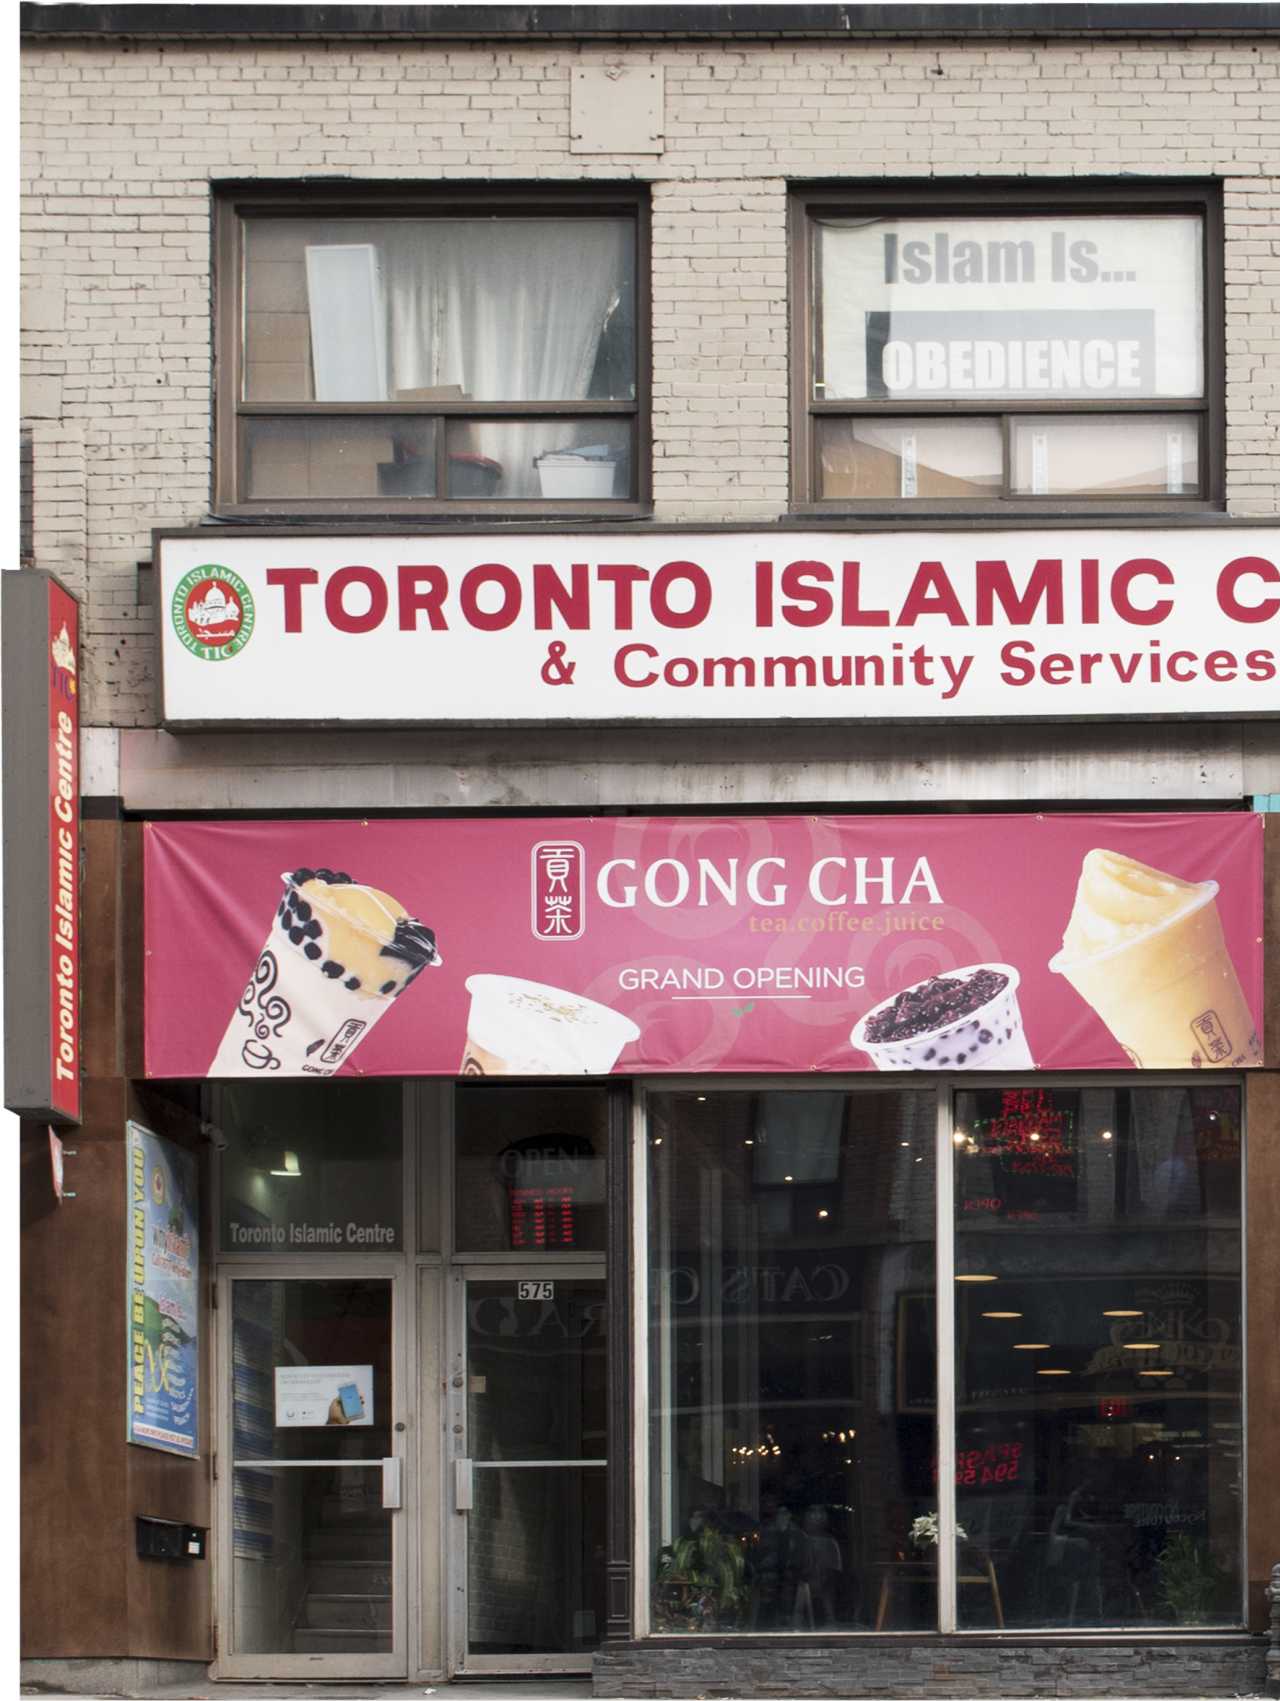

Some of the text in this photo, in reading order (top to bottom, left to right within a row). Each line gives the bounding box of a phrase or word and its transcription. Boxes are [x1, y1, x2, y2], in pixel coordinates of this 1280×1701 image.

[884, 231, 1136, 284] Islam Is...
[881, 340, 1142, 391] OBEDIENCE
[173, 567, 254, 653] TORONTO ISLAMIC CENTRE
[266, 561, 713, 634] TORONTO
[755, 558, 1175, 630] ISLAMIC
[200, 645, 233, 660] TIC
[540, 640, 1277, 700] & Community Services
[54, 711, 74, 1081] Toronto Islamic Centre
[596, 855, 945, 908] GONG CHA
[749, 911, 945, 936] tea.coffee.juice
[618, 966, 865, 990] GRAND OPENING
[302, 1064, 324, 1075] GONG
[501, 1146, 580, 1178] OPEN
[230, 1222, 395, 1244] Toronto Islamic Centre
[133, 1146, 145, 1415] PEACE BE UPON YOU
[519, 1283, 553, 1299] 575
